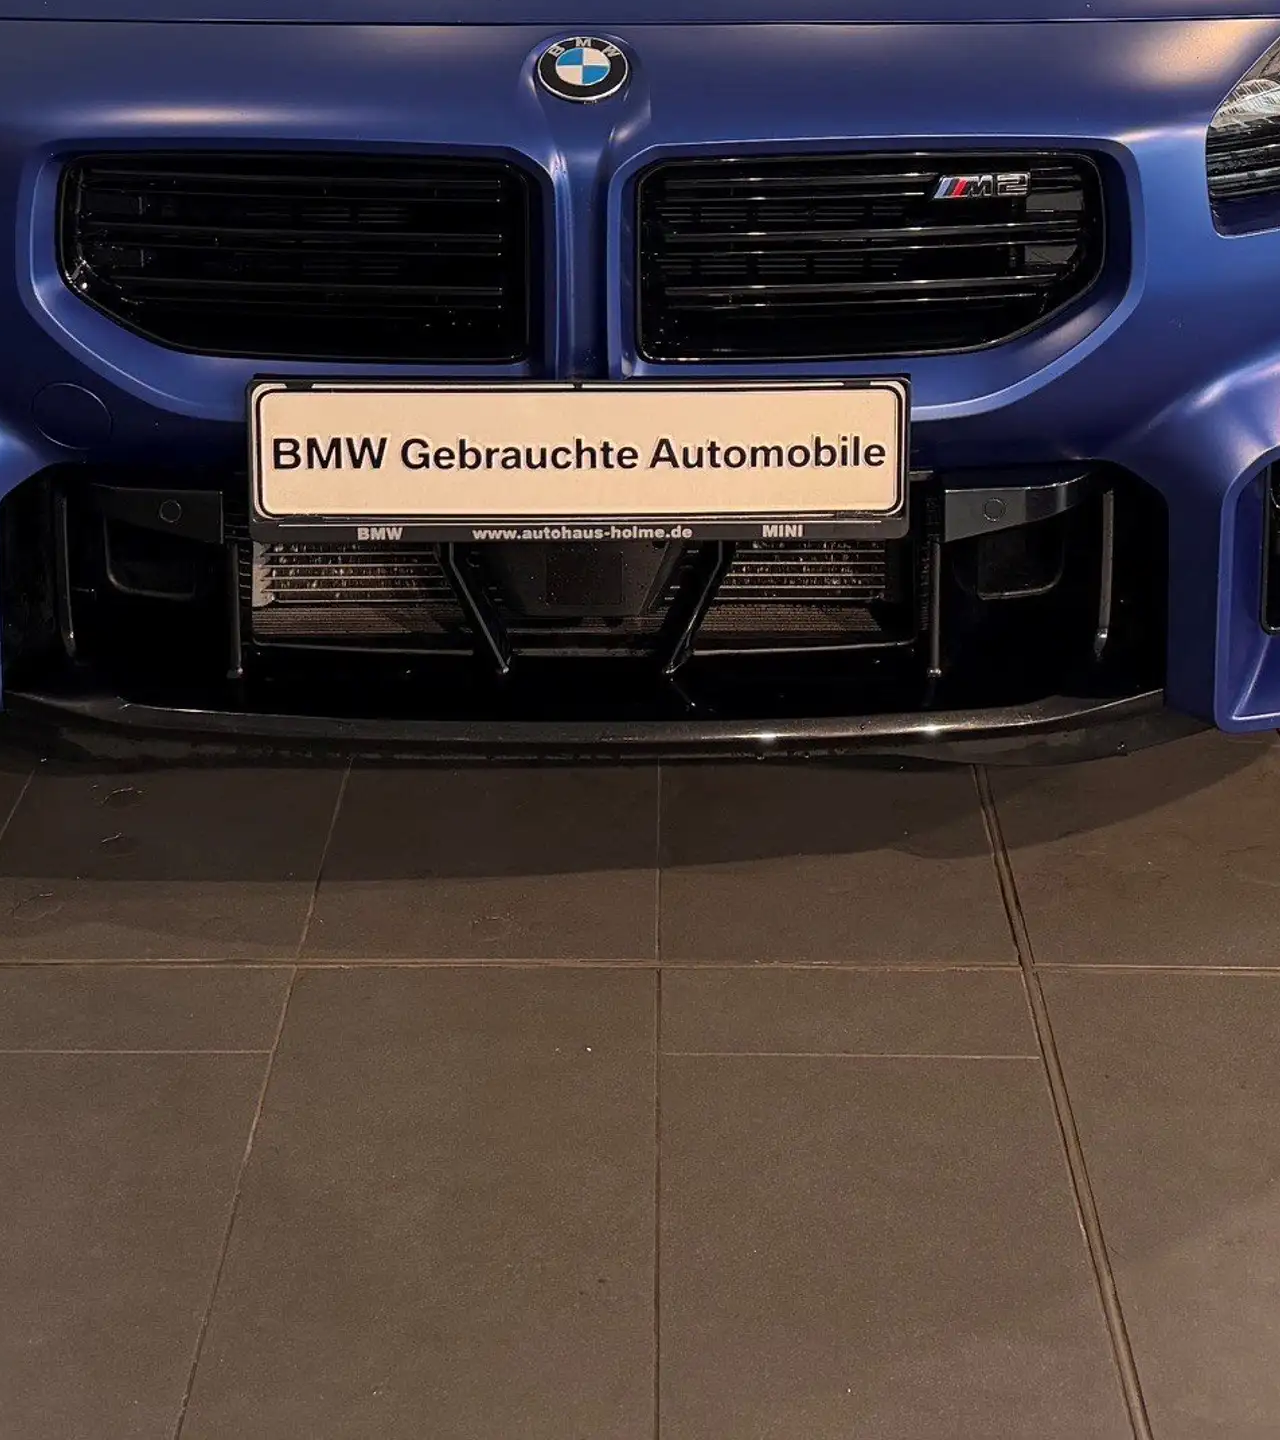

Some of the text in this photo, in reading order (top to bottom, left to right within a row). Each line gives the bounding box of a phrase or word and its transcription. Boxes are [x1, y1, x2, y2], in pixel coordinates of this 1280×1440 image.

[272, 435, 886, 470] BMW Gebrauchte Automobile
[357, 527, 404, 541] BMW
[471, 525, 693, 540] www.autohaus-holme.de
[761, 524, 804, 538] MINI
